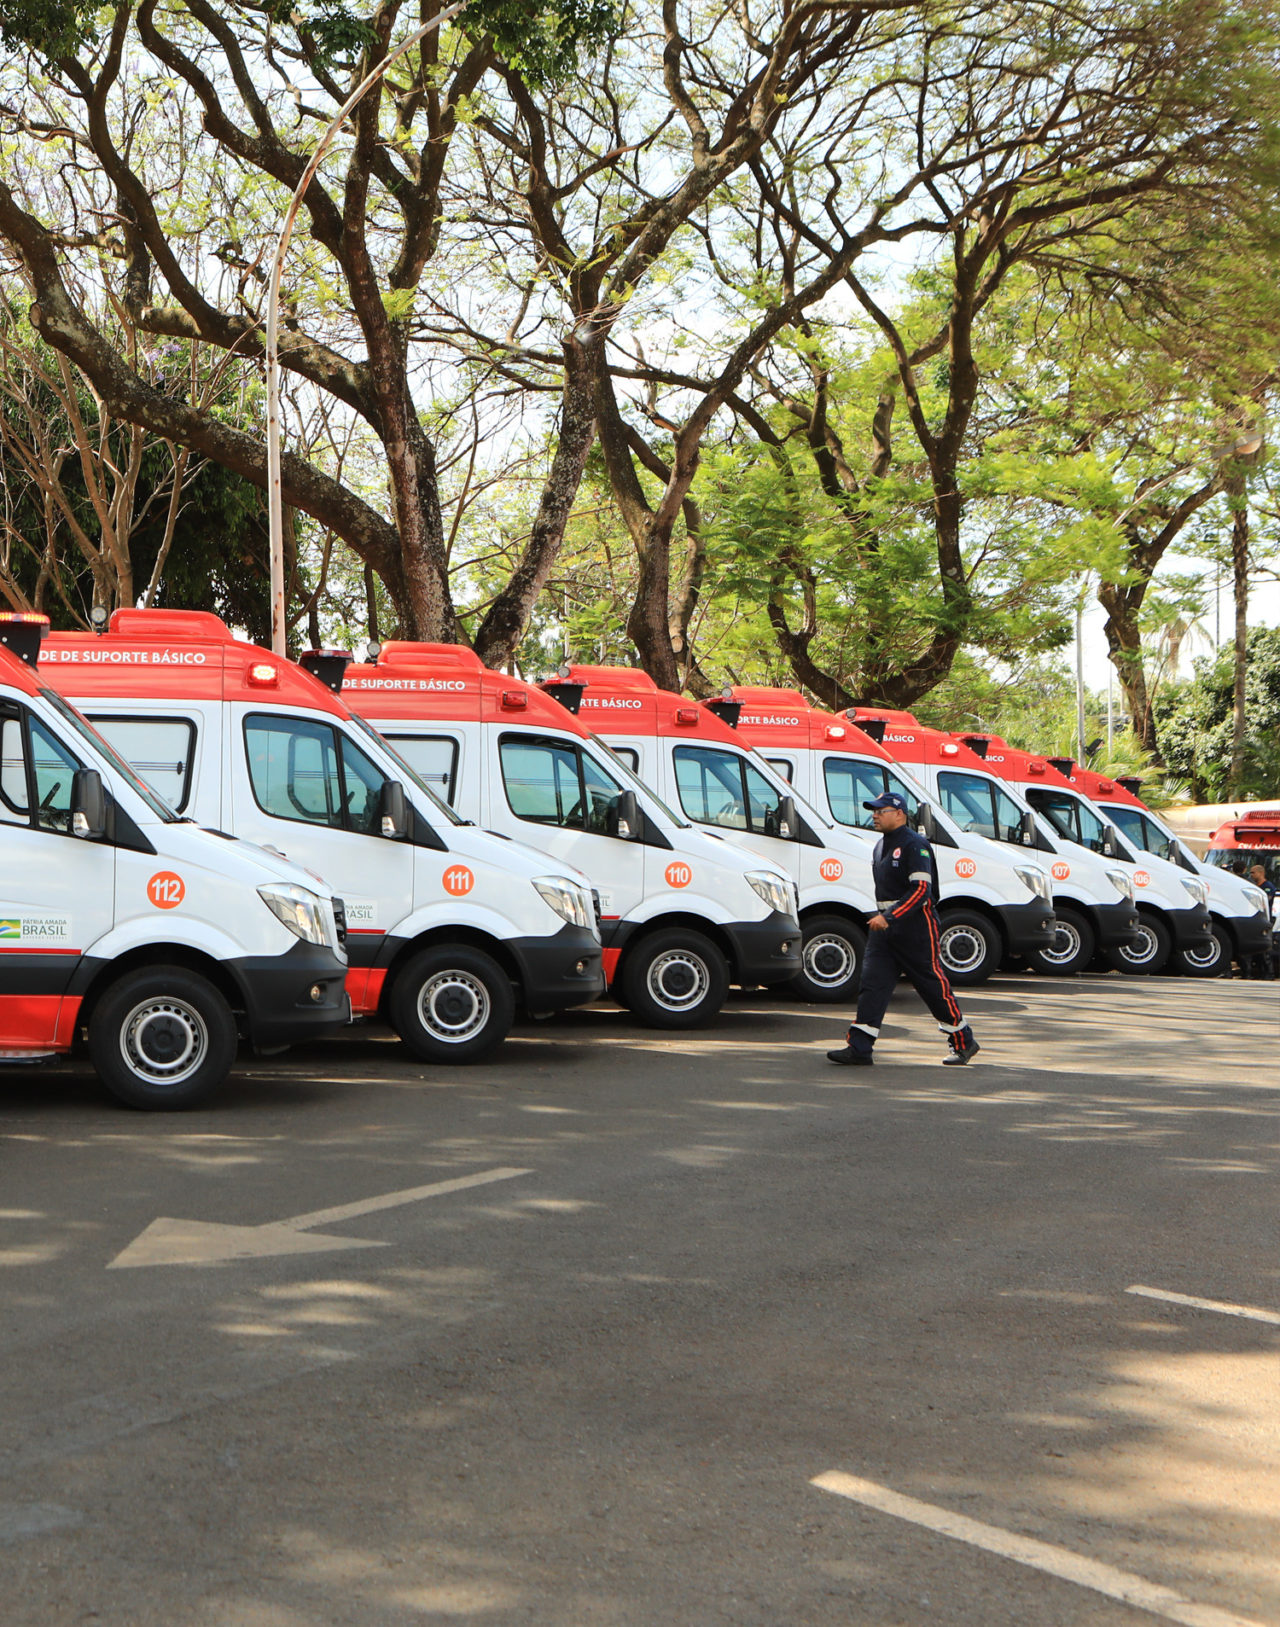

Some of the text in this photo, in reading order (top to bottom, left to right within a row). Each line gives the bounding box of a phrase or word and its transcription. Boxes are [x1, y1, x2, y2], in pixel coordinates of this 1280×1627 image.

[61, 650, 79, 662] DE
[83, 650, 148, 663] SUPORTE
[152, 649, 206, 664] BÁSICO
[360, 679, 417, 690] SUPORTE
[420, 678, 466, 691] BÁSICO
[601, 697, 642, 709] BÁSICO
[737, 714, 799, 726] ORTE BÁSICO
[883, 733, 915, 743] BÁSICO
[821, 862, 841, 877] 109
[957, 861, 975, 875] 108
[1053, 865, 1068, 877] 107
[447, 871, 469, 890] 111
[668, 867, 689, 883] 110
[1134, 874, 1149, 884] 106
[151, 878, 181, 902] 112
[346, 910, 373, 919] RASIL
[22, 925, 68, 936] BRASIL
